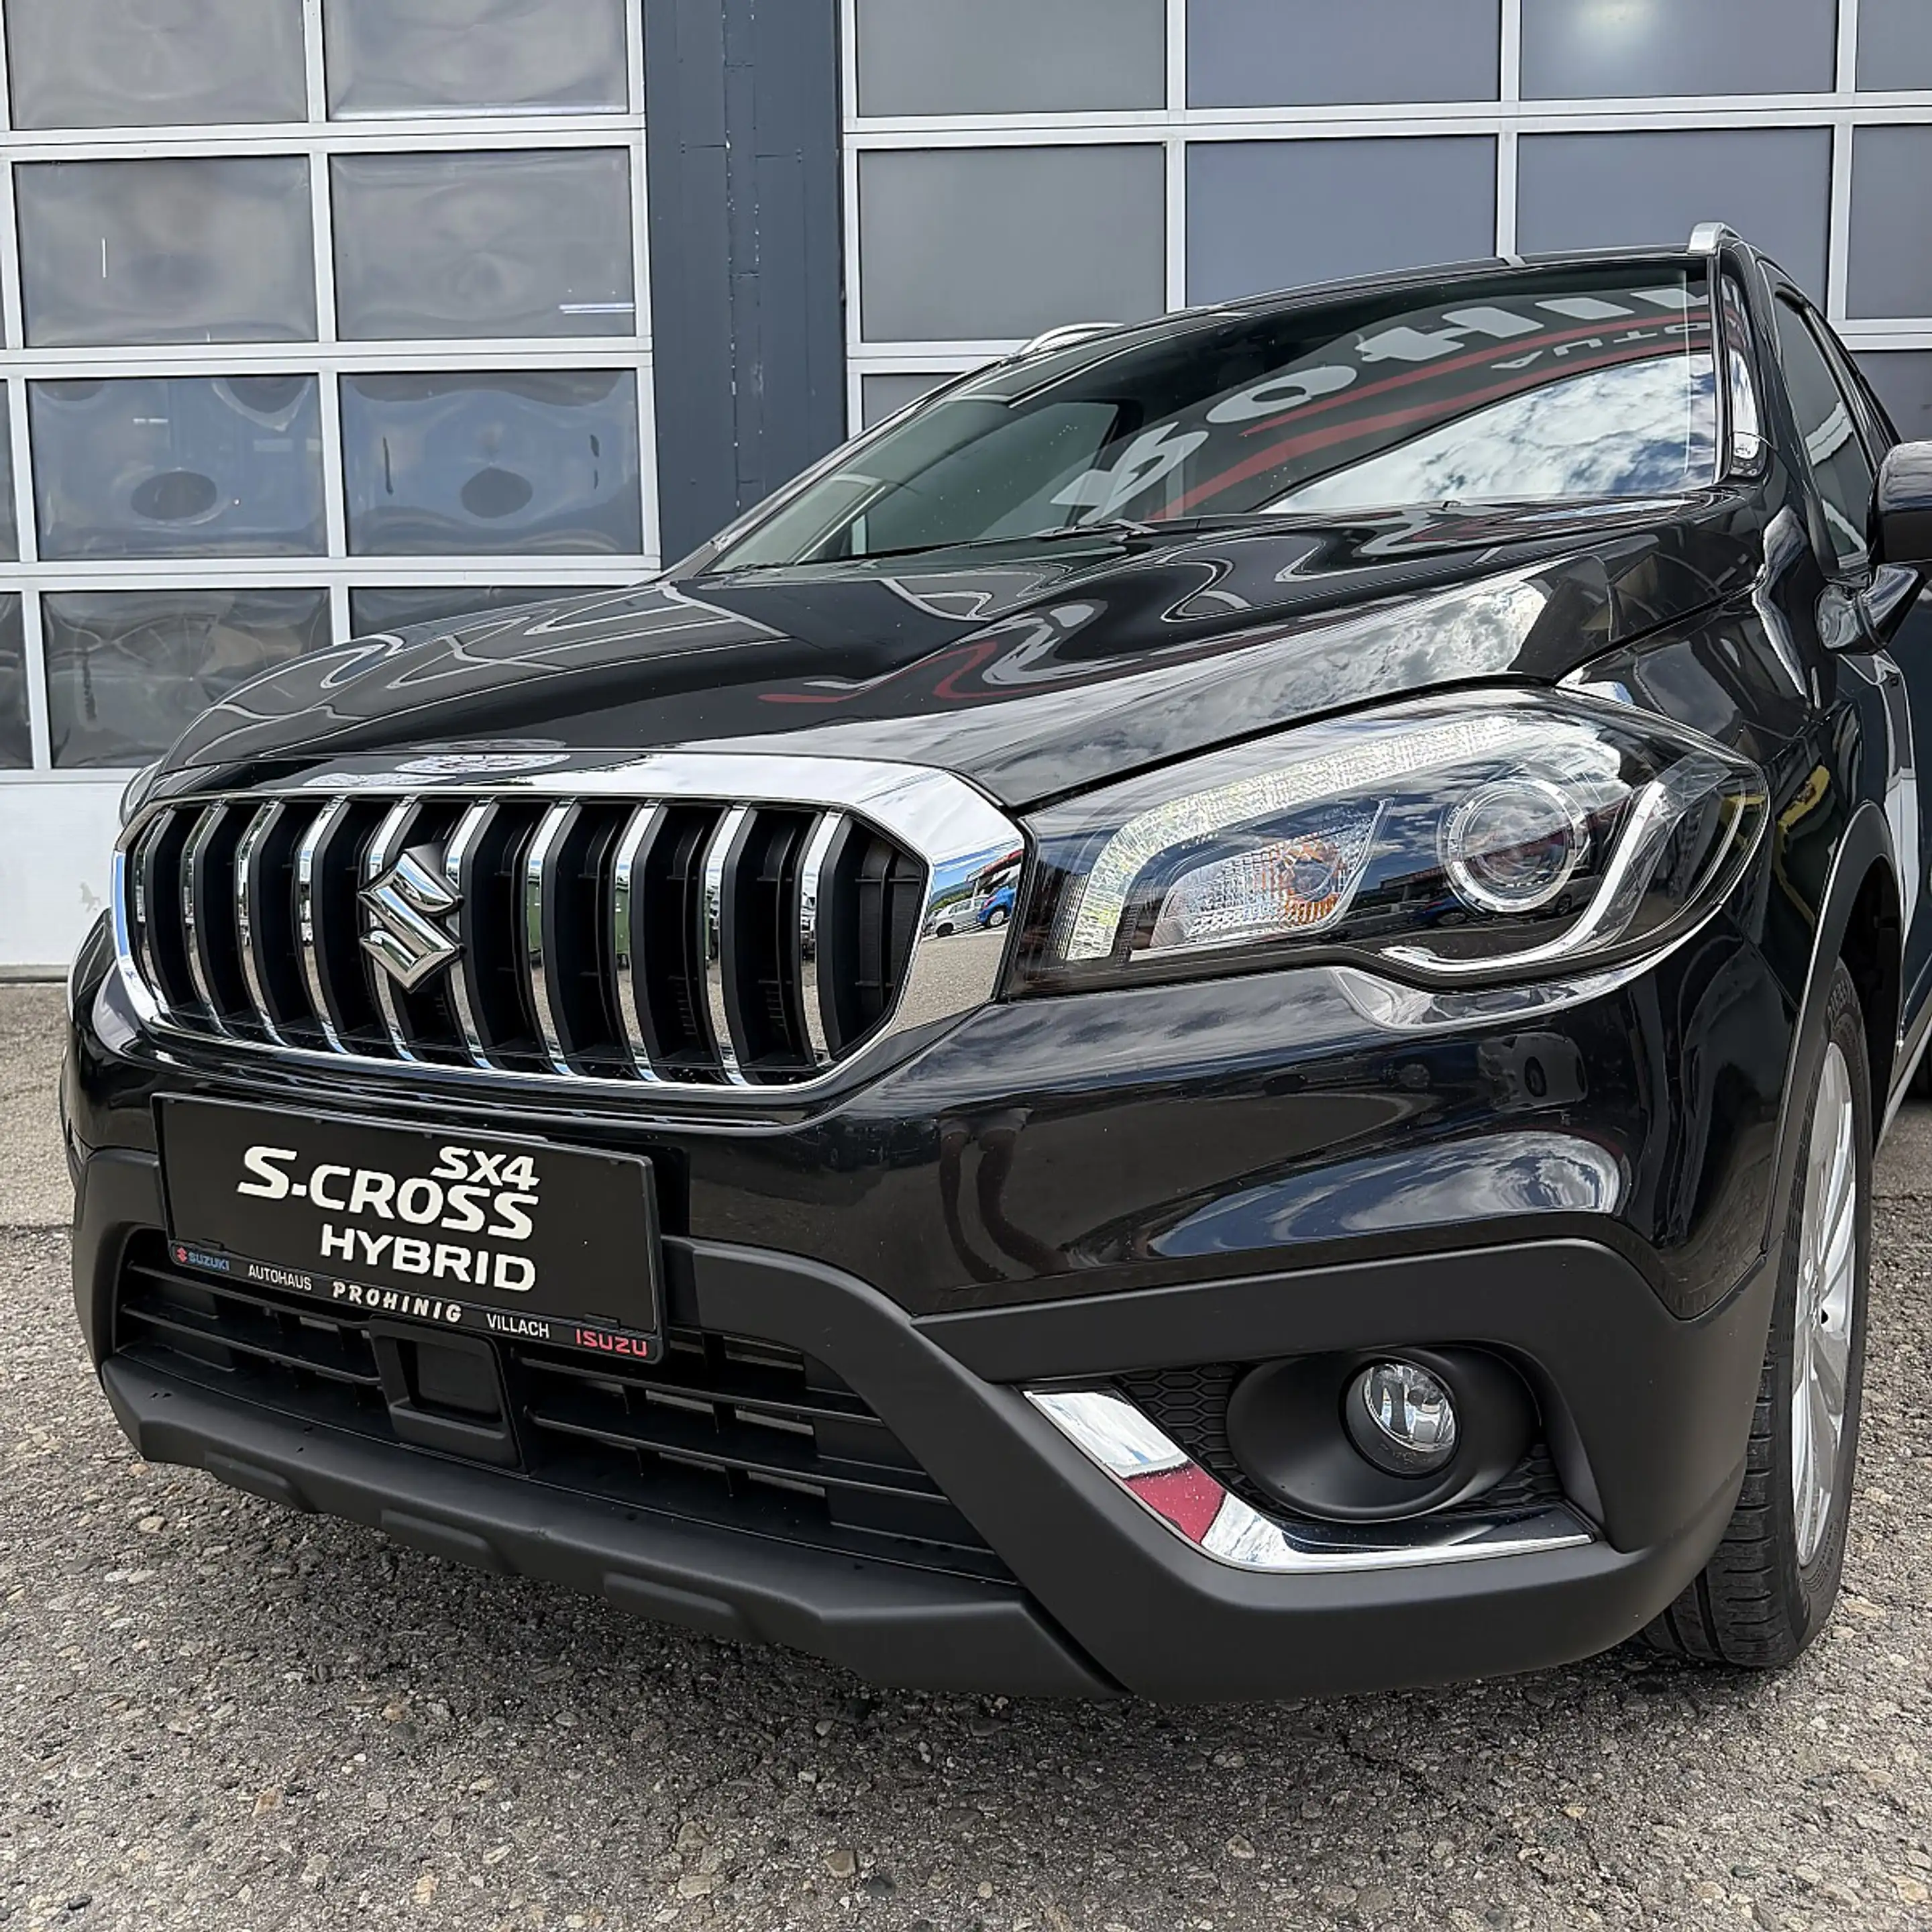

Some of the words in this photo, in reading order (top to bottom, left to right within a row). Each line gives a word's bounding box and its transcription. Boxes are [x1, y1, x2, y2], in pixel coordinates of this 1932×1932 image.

[429, 1146, 541, 1191] SX4
[320, 1223, 537, 1292] HYBRID
[187, 1250, 230, 1272] SUZUKI
[247, 1264, 313, 1291] AUTOHAUS
[332, 1281, 463, 1324] PROHINIG
[485, 1312, 551, 1339] VILLACH
[576, 1328, 648, 1357] ISUZU
